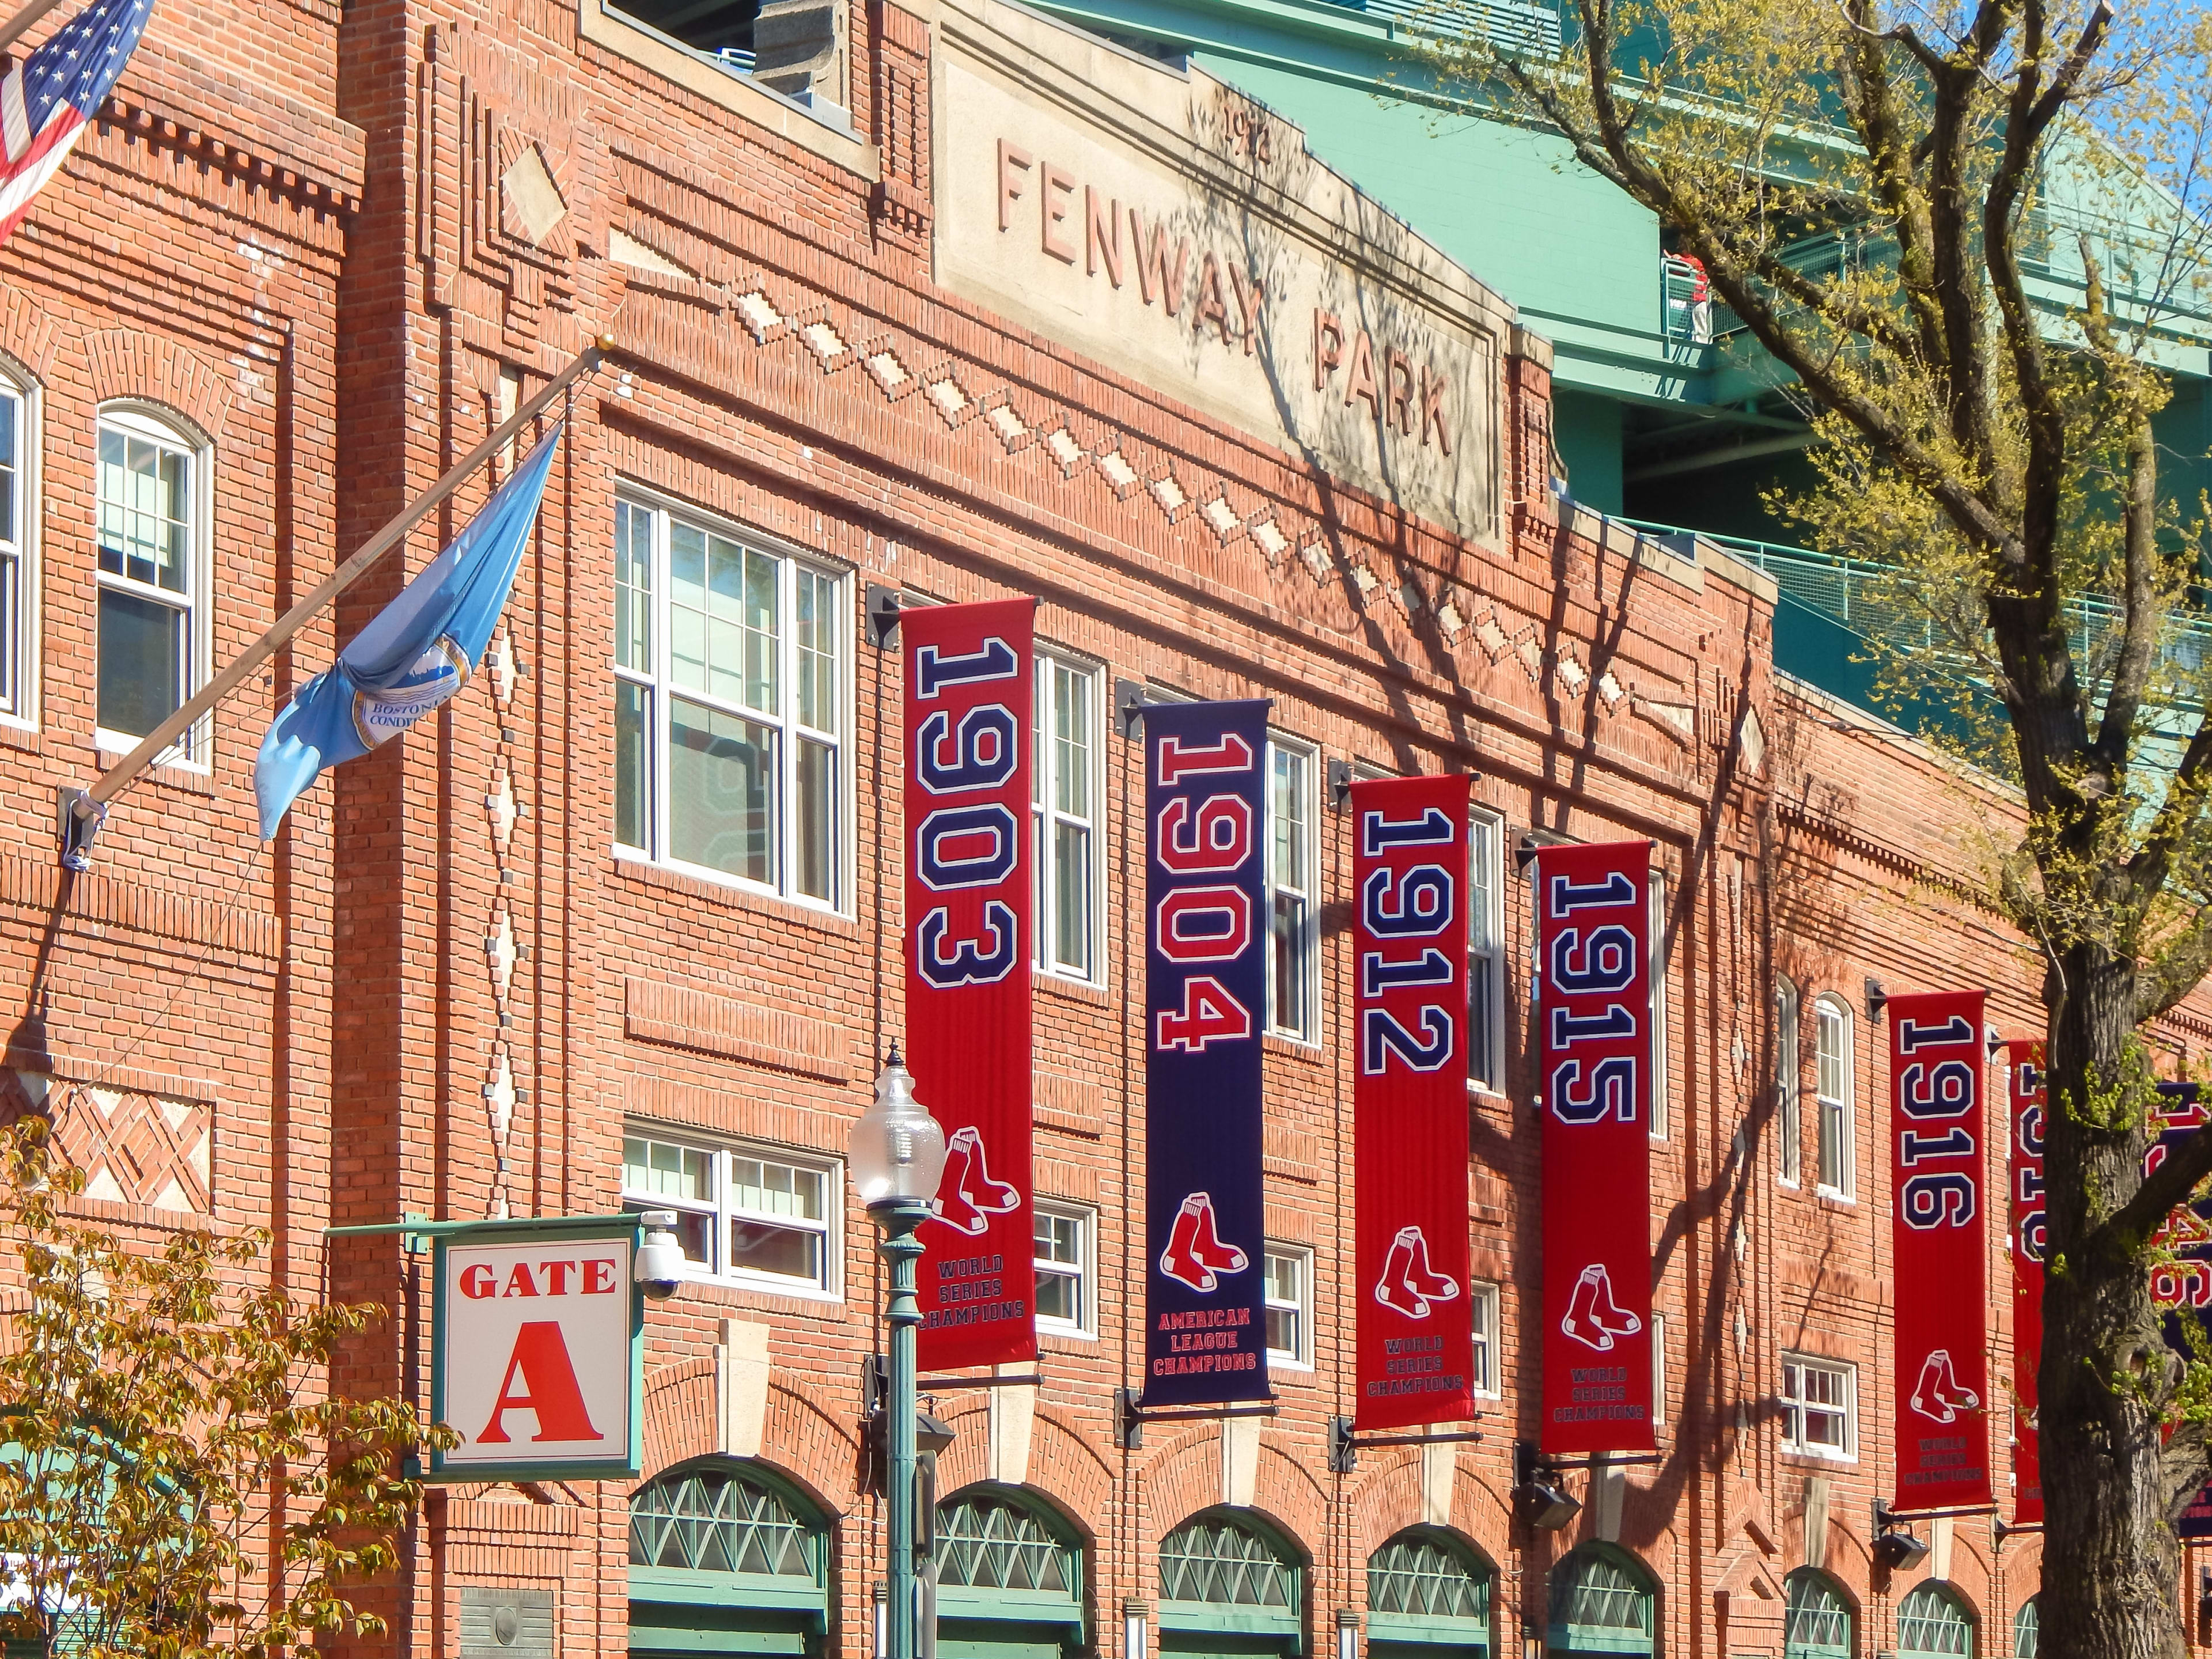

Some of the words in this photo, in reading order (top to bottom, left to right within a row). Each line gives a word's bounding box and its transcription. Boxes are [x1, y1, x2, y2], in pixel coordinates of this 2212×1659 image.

[1224, 104, 1271, 165] 1912
[997, 137, 1264, 356] FENWAY
[1313, 307, 1451, 456] PARK
[916, 637, 1018, 989] 1903
[1157, 733, 1253, 1052] 1904
[1363, 808, 1454, 1075] 1912
[1551, 872, 1636, 1124] 1915
[1900, 1015, 1975, 1230] 1916
[2144, 1103, 2211, 1309] 146
[459, 1259, 616, 1299] GATE
[937, 1255, 1002, 1279] WORLD
[940, 1279, 1002, 1303] SERIES
[918, 1301, 1024, 1330] CHAMPIONS
[1158, 1308, 1249, 1330] AMERICAN
[1171, 1331, 1237, 1352] LEAGUE
[1385, 1335, 1444, 1354] WORLD
[1154, 1353, 1256, 1376] CHAMPIONS
[1387, 1356, 1443, 1374] SERIES
[1570, 1367, 1627, 1383] WORLD
[476, 1321, 604, 1443] A
[1367, 1375, 1463, 1396] CHAMPIONS
[1573, 1386, 1626, 1402] SERIES
[1554, 1405, 1644, 1422] CHAMPIONS
